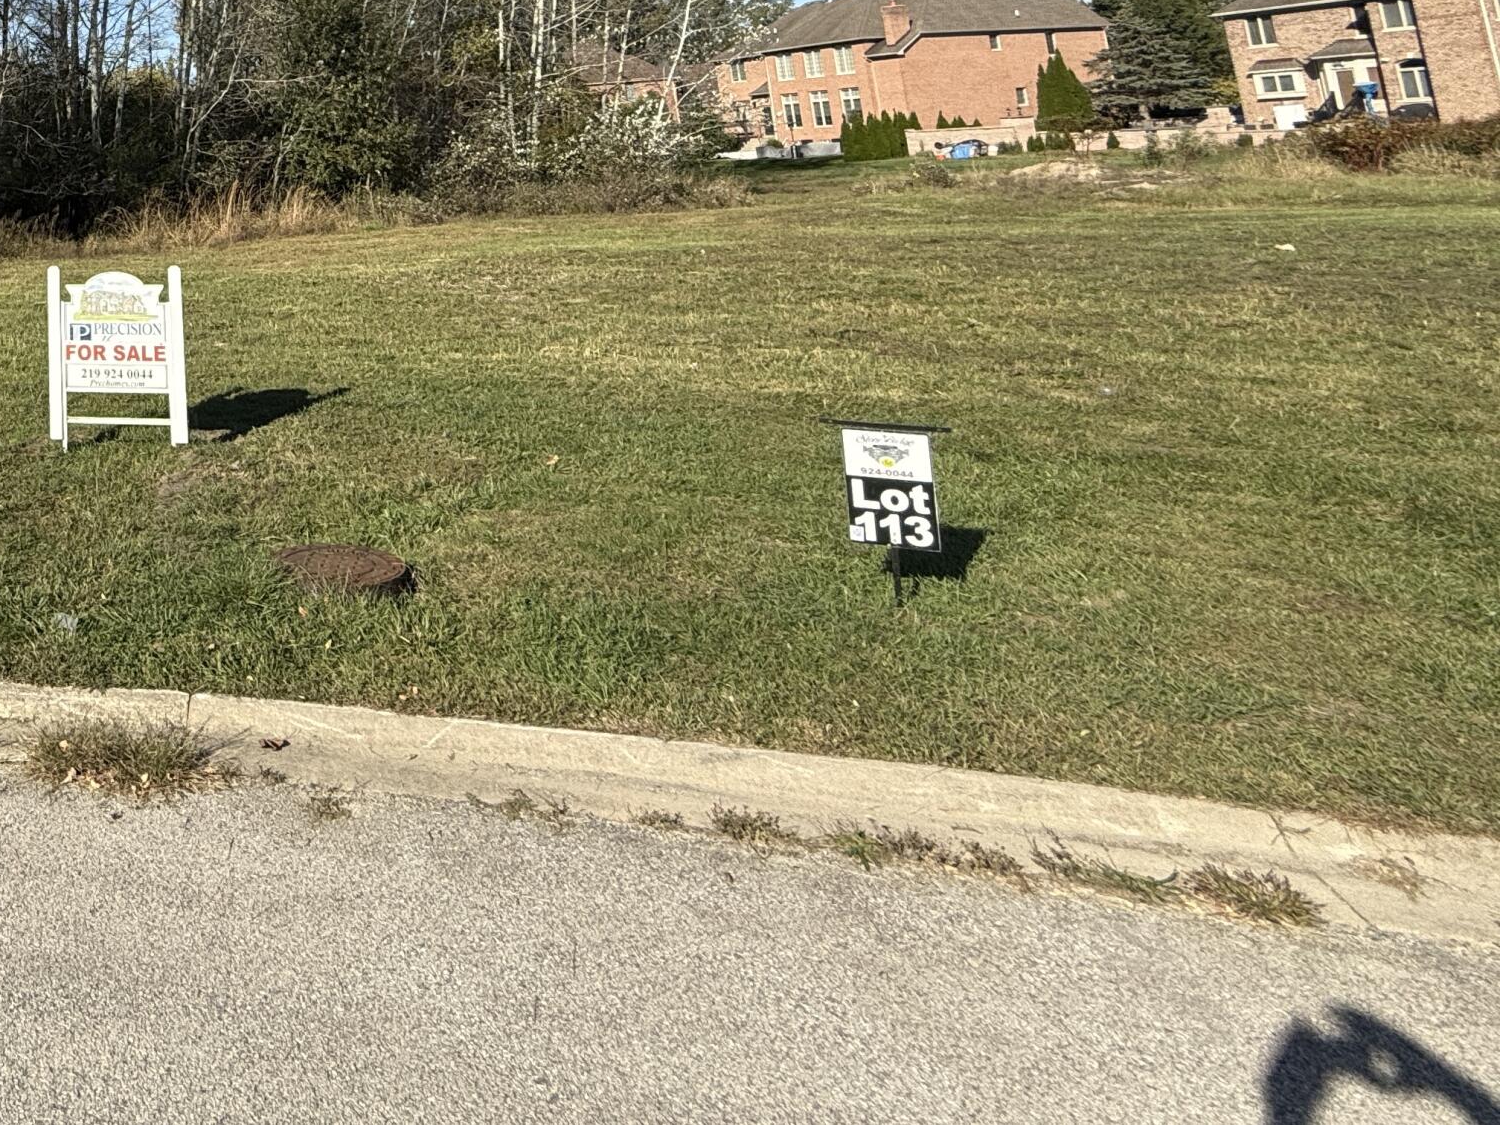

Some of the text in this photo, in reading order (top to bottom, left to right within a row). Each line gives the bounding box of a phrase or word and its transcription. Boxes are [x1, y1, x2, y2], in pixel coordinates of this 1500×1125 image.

[94, 323, 162, 335] PRECISION
[66, 344, 166, 361] FOR SALE
[81, 368, 153, 379] 219 924 0044
[860, 467, 914, 478] 924-0044
[851, 478, 931, 515] Lot
[854, 511, 934, 548] 113
